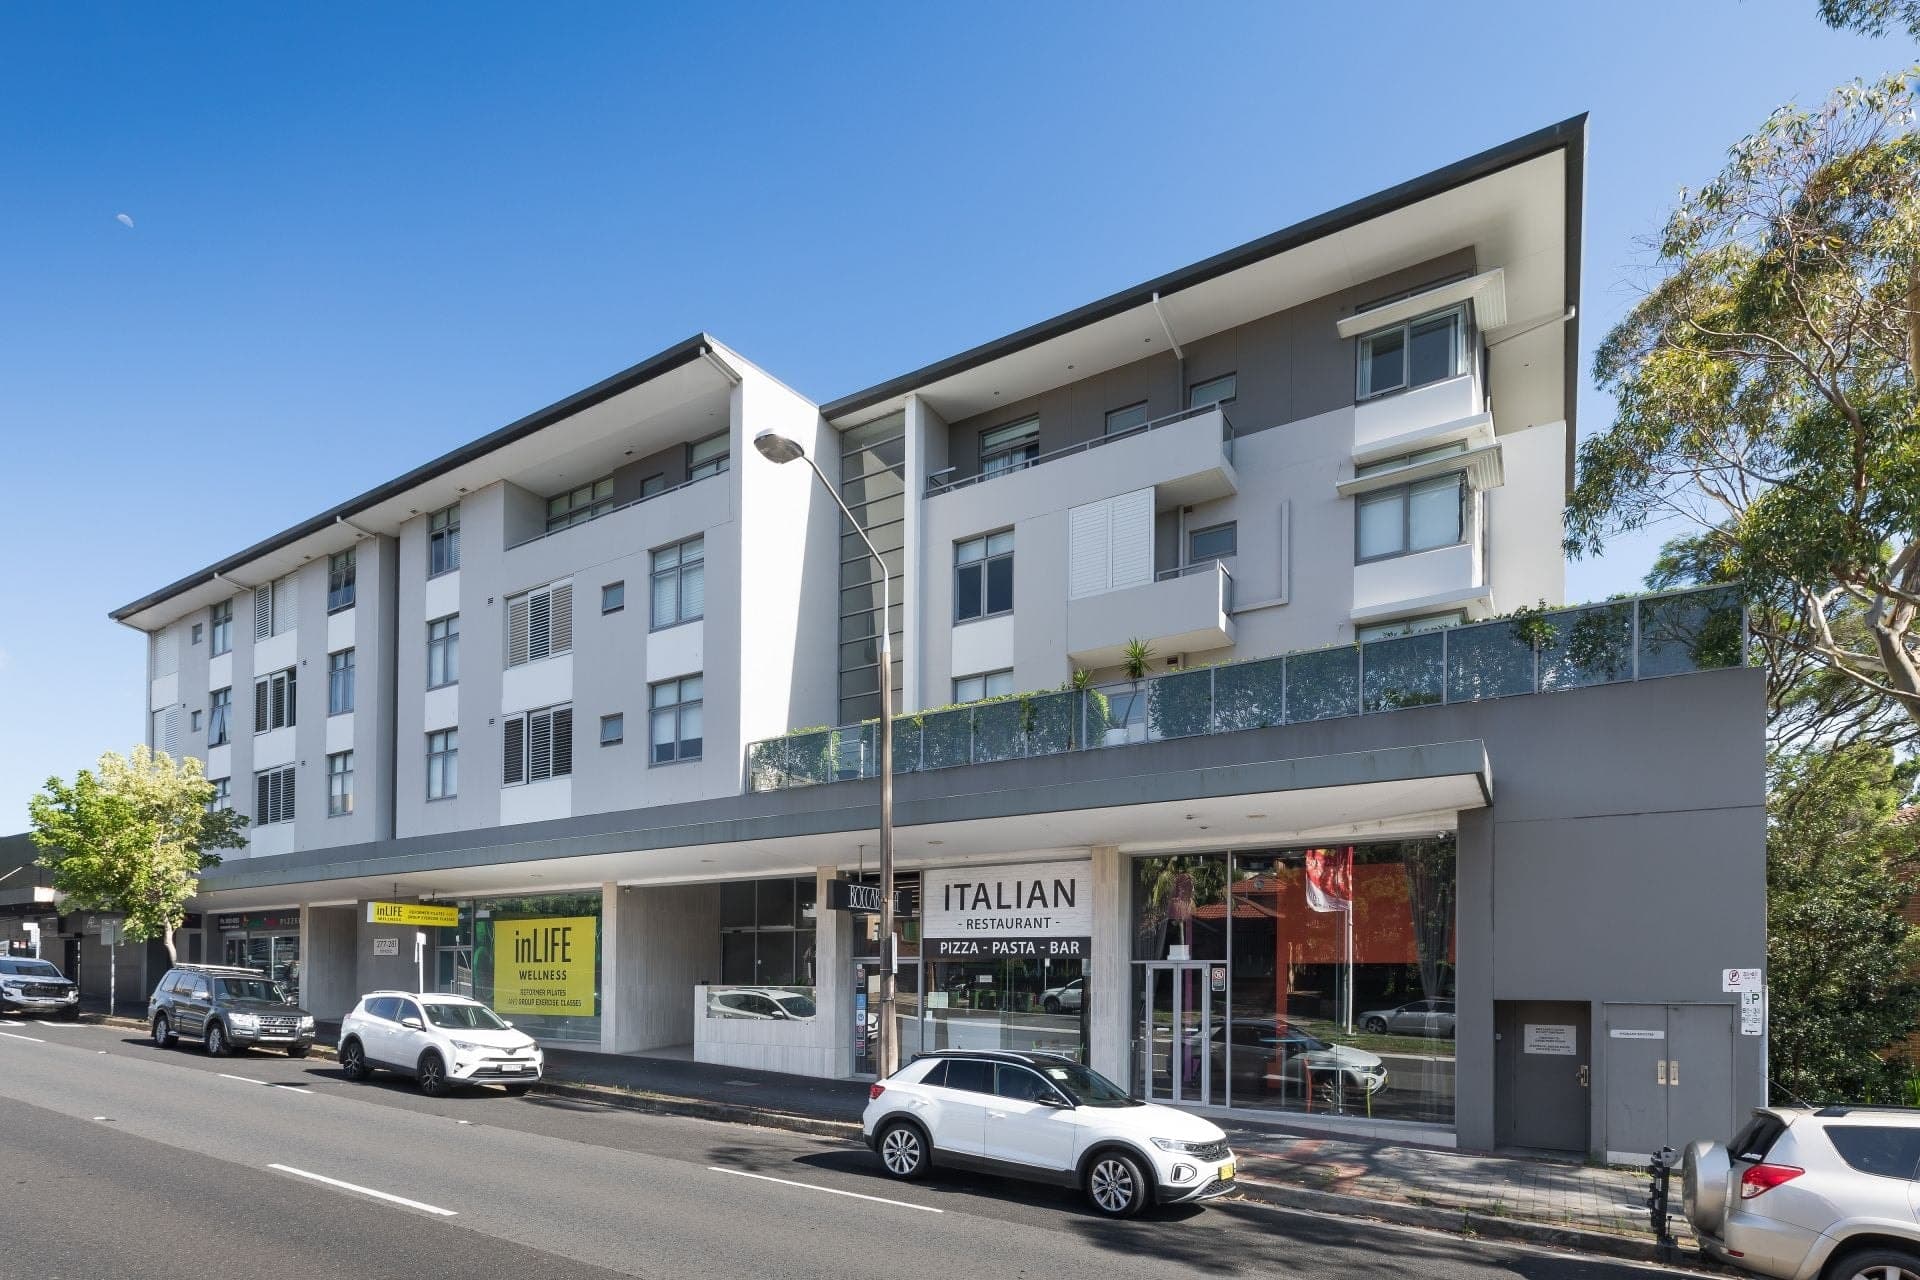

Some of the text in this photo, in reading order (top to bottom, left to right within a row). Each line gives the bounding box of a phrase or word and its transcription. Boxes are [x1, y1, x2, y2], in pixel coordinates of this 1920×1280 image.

[944, 878, 1076, 911] ITALIAN
[377, 905, 403, 917] inLIFE
[966, 917, 1052, 930] RESTAURANT
[515, 927, 572, 963] inLIFE
[940, 941, 979, 954] PIZZA
[992, 941, 1036, 954] PASTA
[1050, 941, 1080, 954] BAR
[519, 970, 567, 981] WELLNESS
